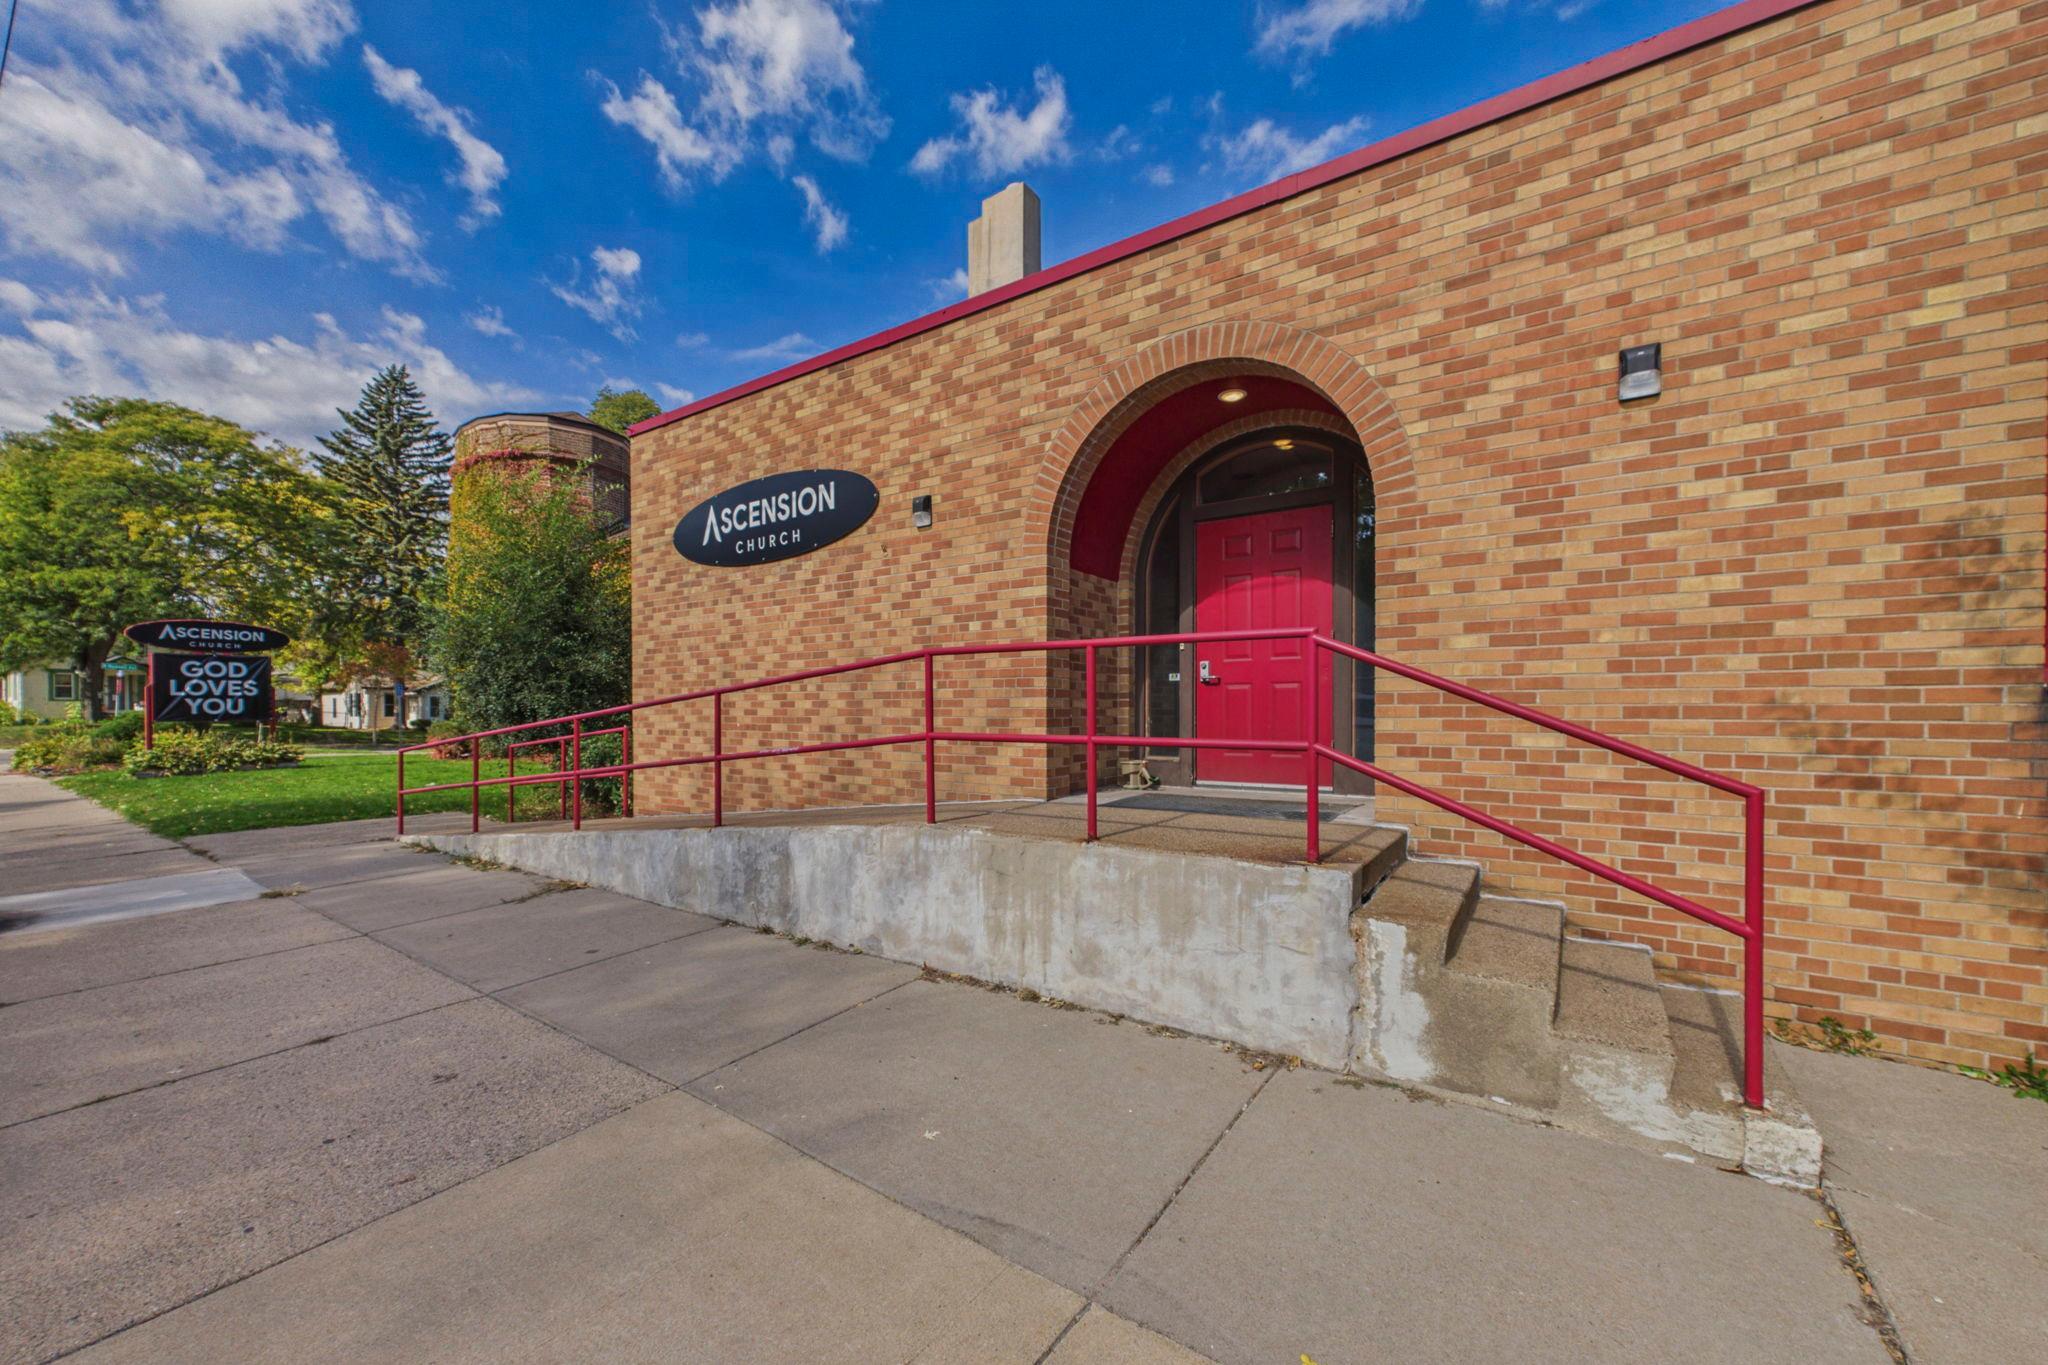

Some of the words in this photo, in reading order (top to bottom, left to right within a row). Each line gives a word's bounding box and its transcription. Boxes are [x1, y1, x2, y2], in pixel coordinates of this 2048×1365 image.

[702, 481, 835, 546] ASCENSION
[735, 529, 801, 554] CHURCH
[159, 624, 265, 642] ASCENSION
[189, 641, 242, 649] CHURCH
[181, 661, 248, 678] GOD
[170, 679, 258, 696] LOVES
[185, 698, 244, 715] YOU
